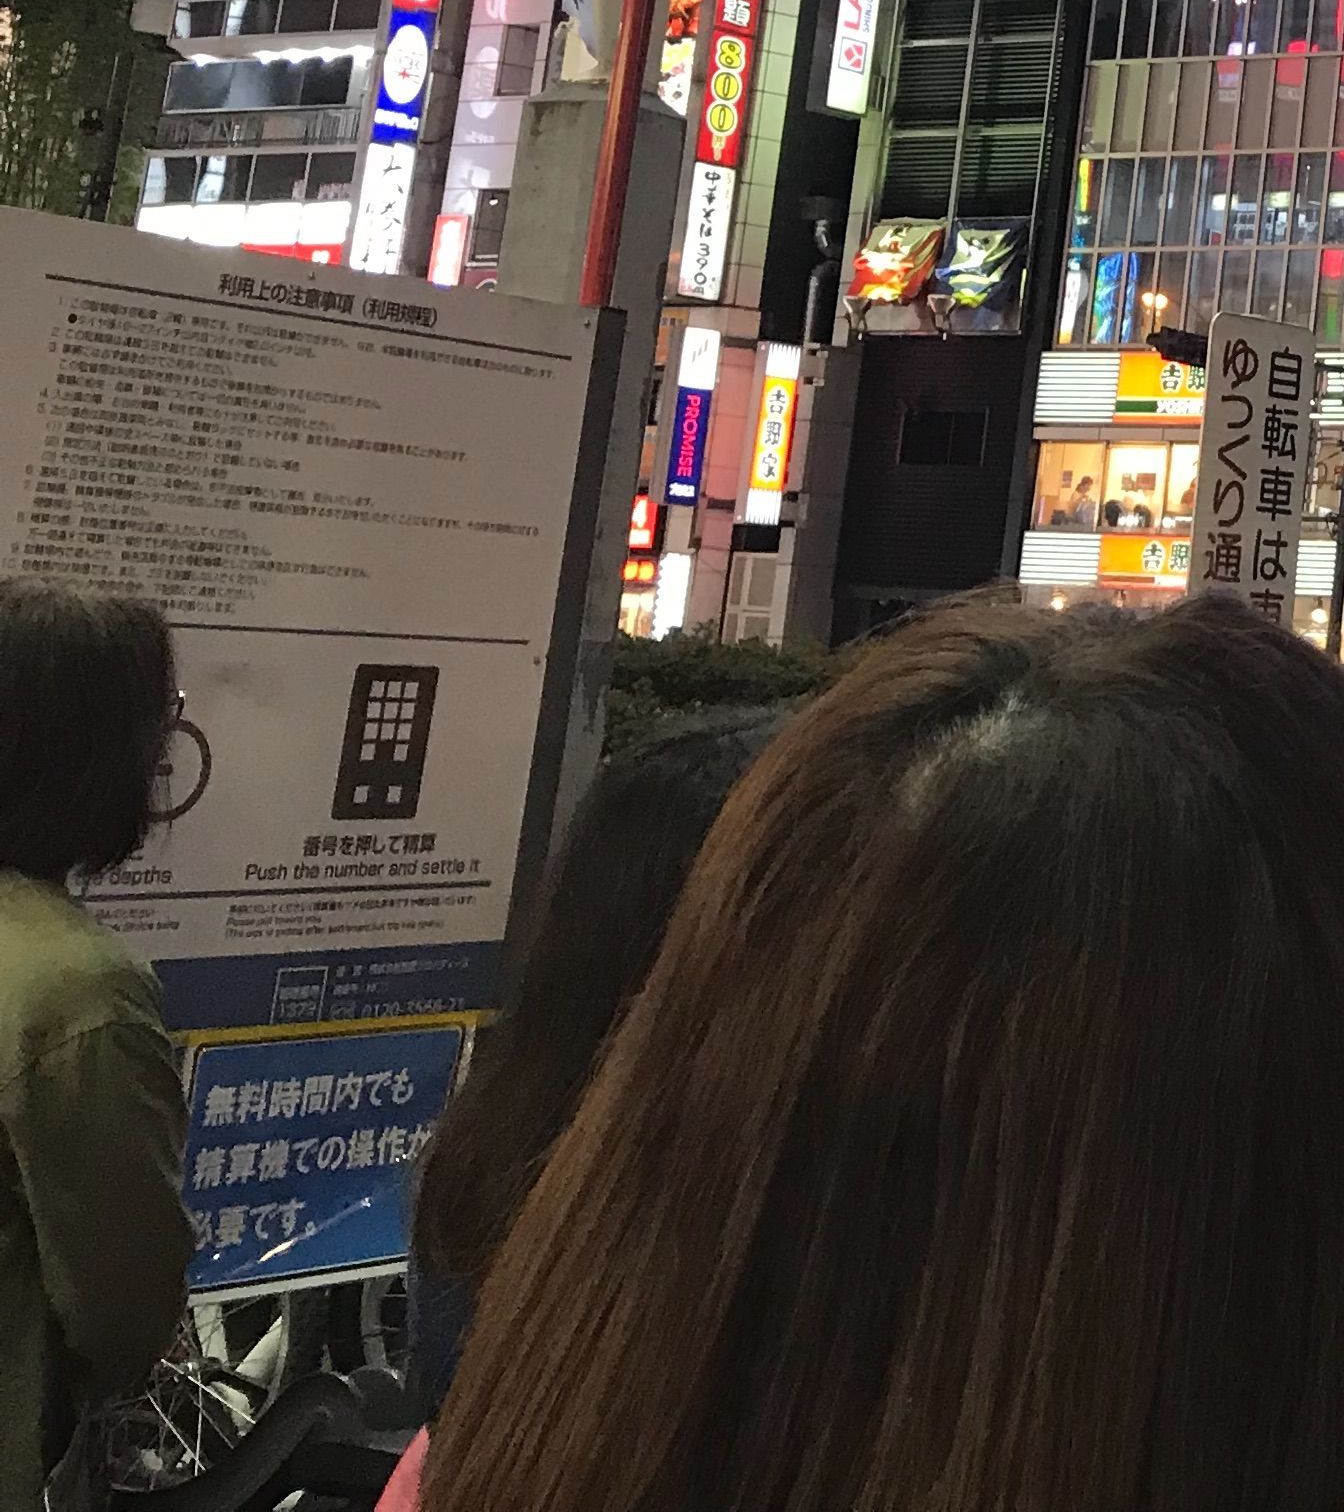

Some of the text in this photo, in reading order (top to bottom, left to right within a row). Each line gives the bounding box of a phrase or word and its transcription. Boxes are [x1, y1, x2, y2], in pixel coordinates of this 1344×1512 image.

[676, 394, 701, 478] PROMISE
[760, 389, 788, 481] 吉野家
[245, 861, 288, 882] Push
[293, 861, 320, 879] the
[323, 859, 384, 878] number
[387, 858, 417, 876] and
[420, 858, 463, 876] settle
[203, 1066, 415, 1128] 無料時間内でも
